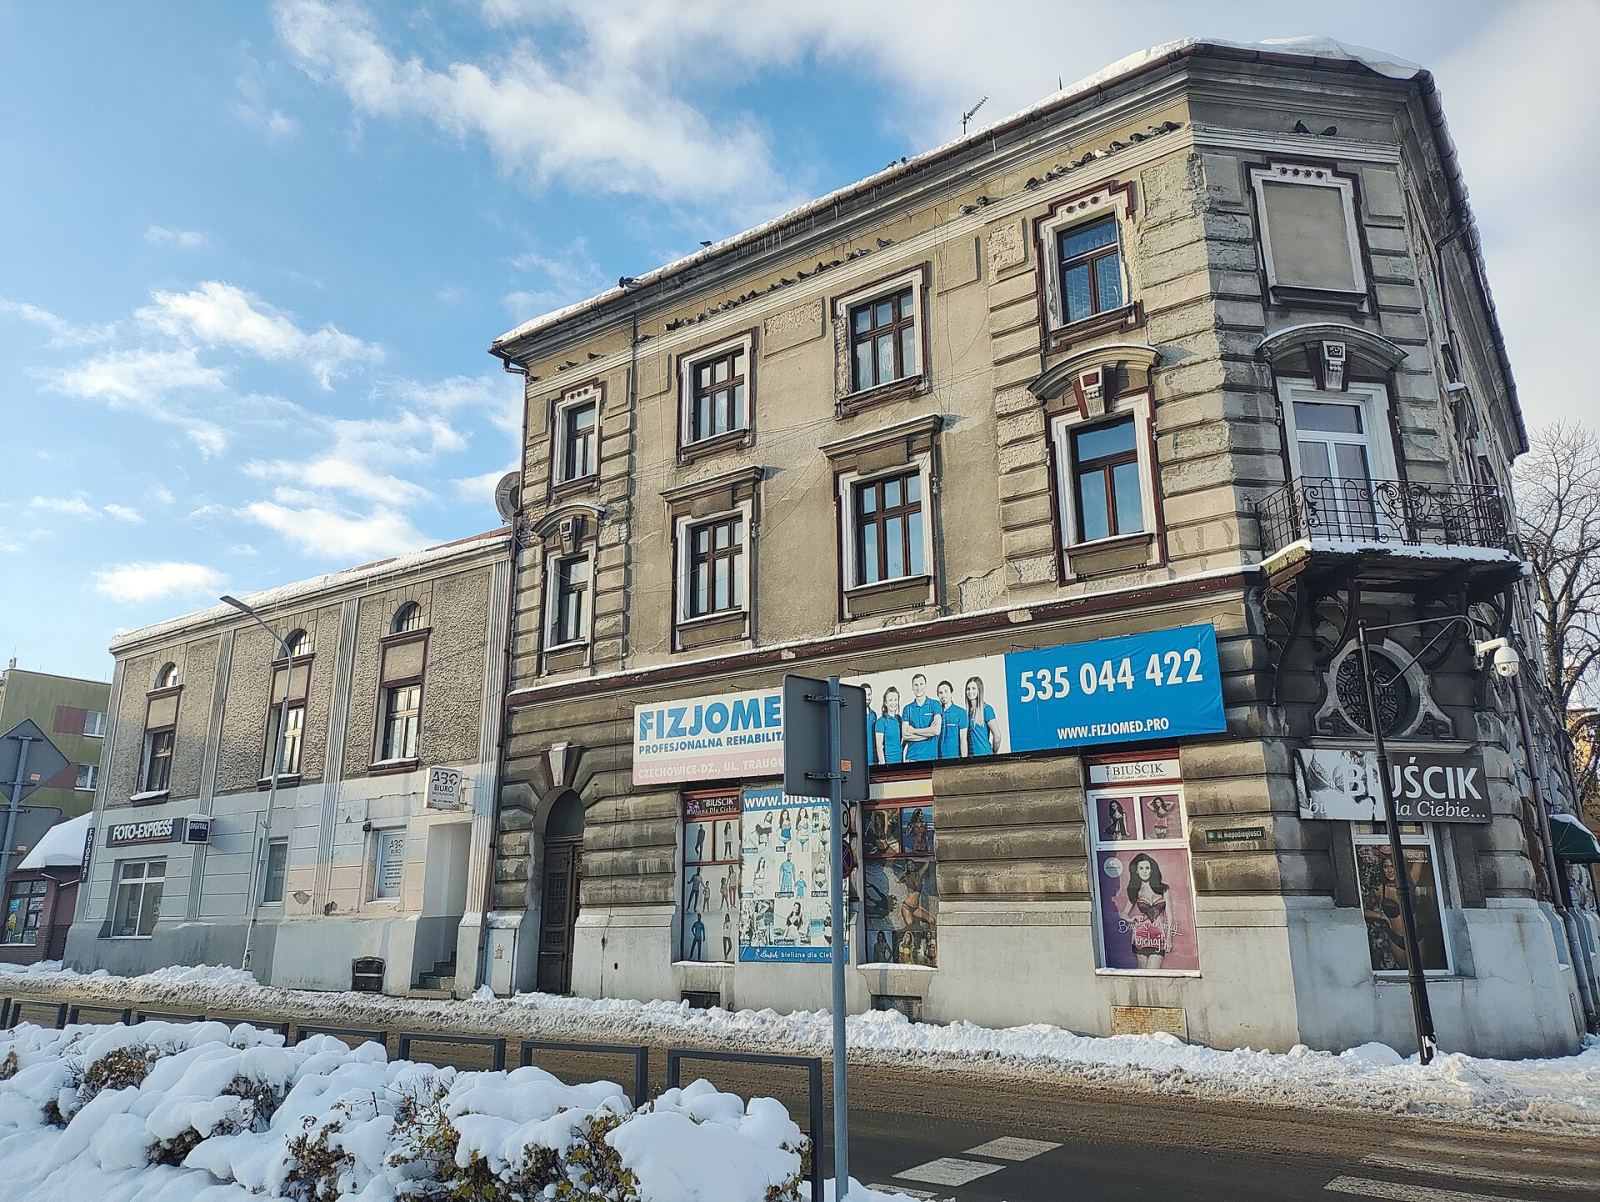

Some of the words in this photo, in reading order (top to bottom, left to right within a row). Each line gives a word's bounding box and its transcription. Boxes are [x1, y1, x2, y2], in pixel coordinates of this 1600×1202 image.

[1020, 665, 1071, 703] 535
[1079, 657, 1136, 695] 044
[1145, 648, 1204, 687] 422
[639, 695, 782, 741] FIZJOME
[1056, 717, 1170, 740] WWW.FIZJOMED.PRO
[639, 737, 723, 755] PROFESJONALNA
[726, 731, 784, 747] REHABILIT
[638, 763, 721, 779] CZECHOWICE-DZ.,
[724, 761, 740, 772] UL.
[742, 757, 784, 770] TRAUGU
[1112, 762, 1164, 775] BIUŚCIK
[433, 784, 454, 793] BIURO
[1395, 800, 1412, 816] la
[1417, 801, 1486, 818] Ciebie...
[112, 819, 174, 840] FOTO-EXPRESS
[189, 822, 208, 830] DIGITAL
[81, 828, 95, 881] FOTOGRAF
